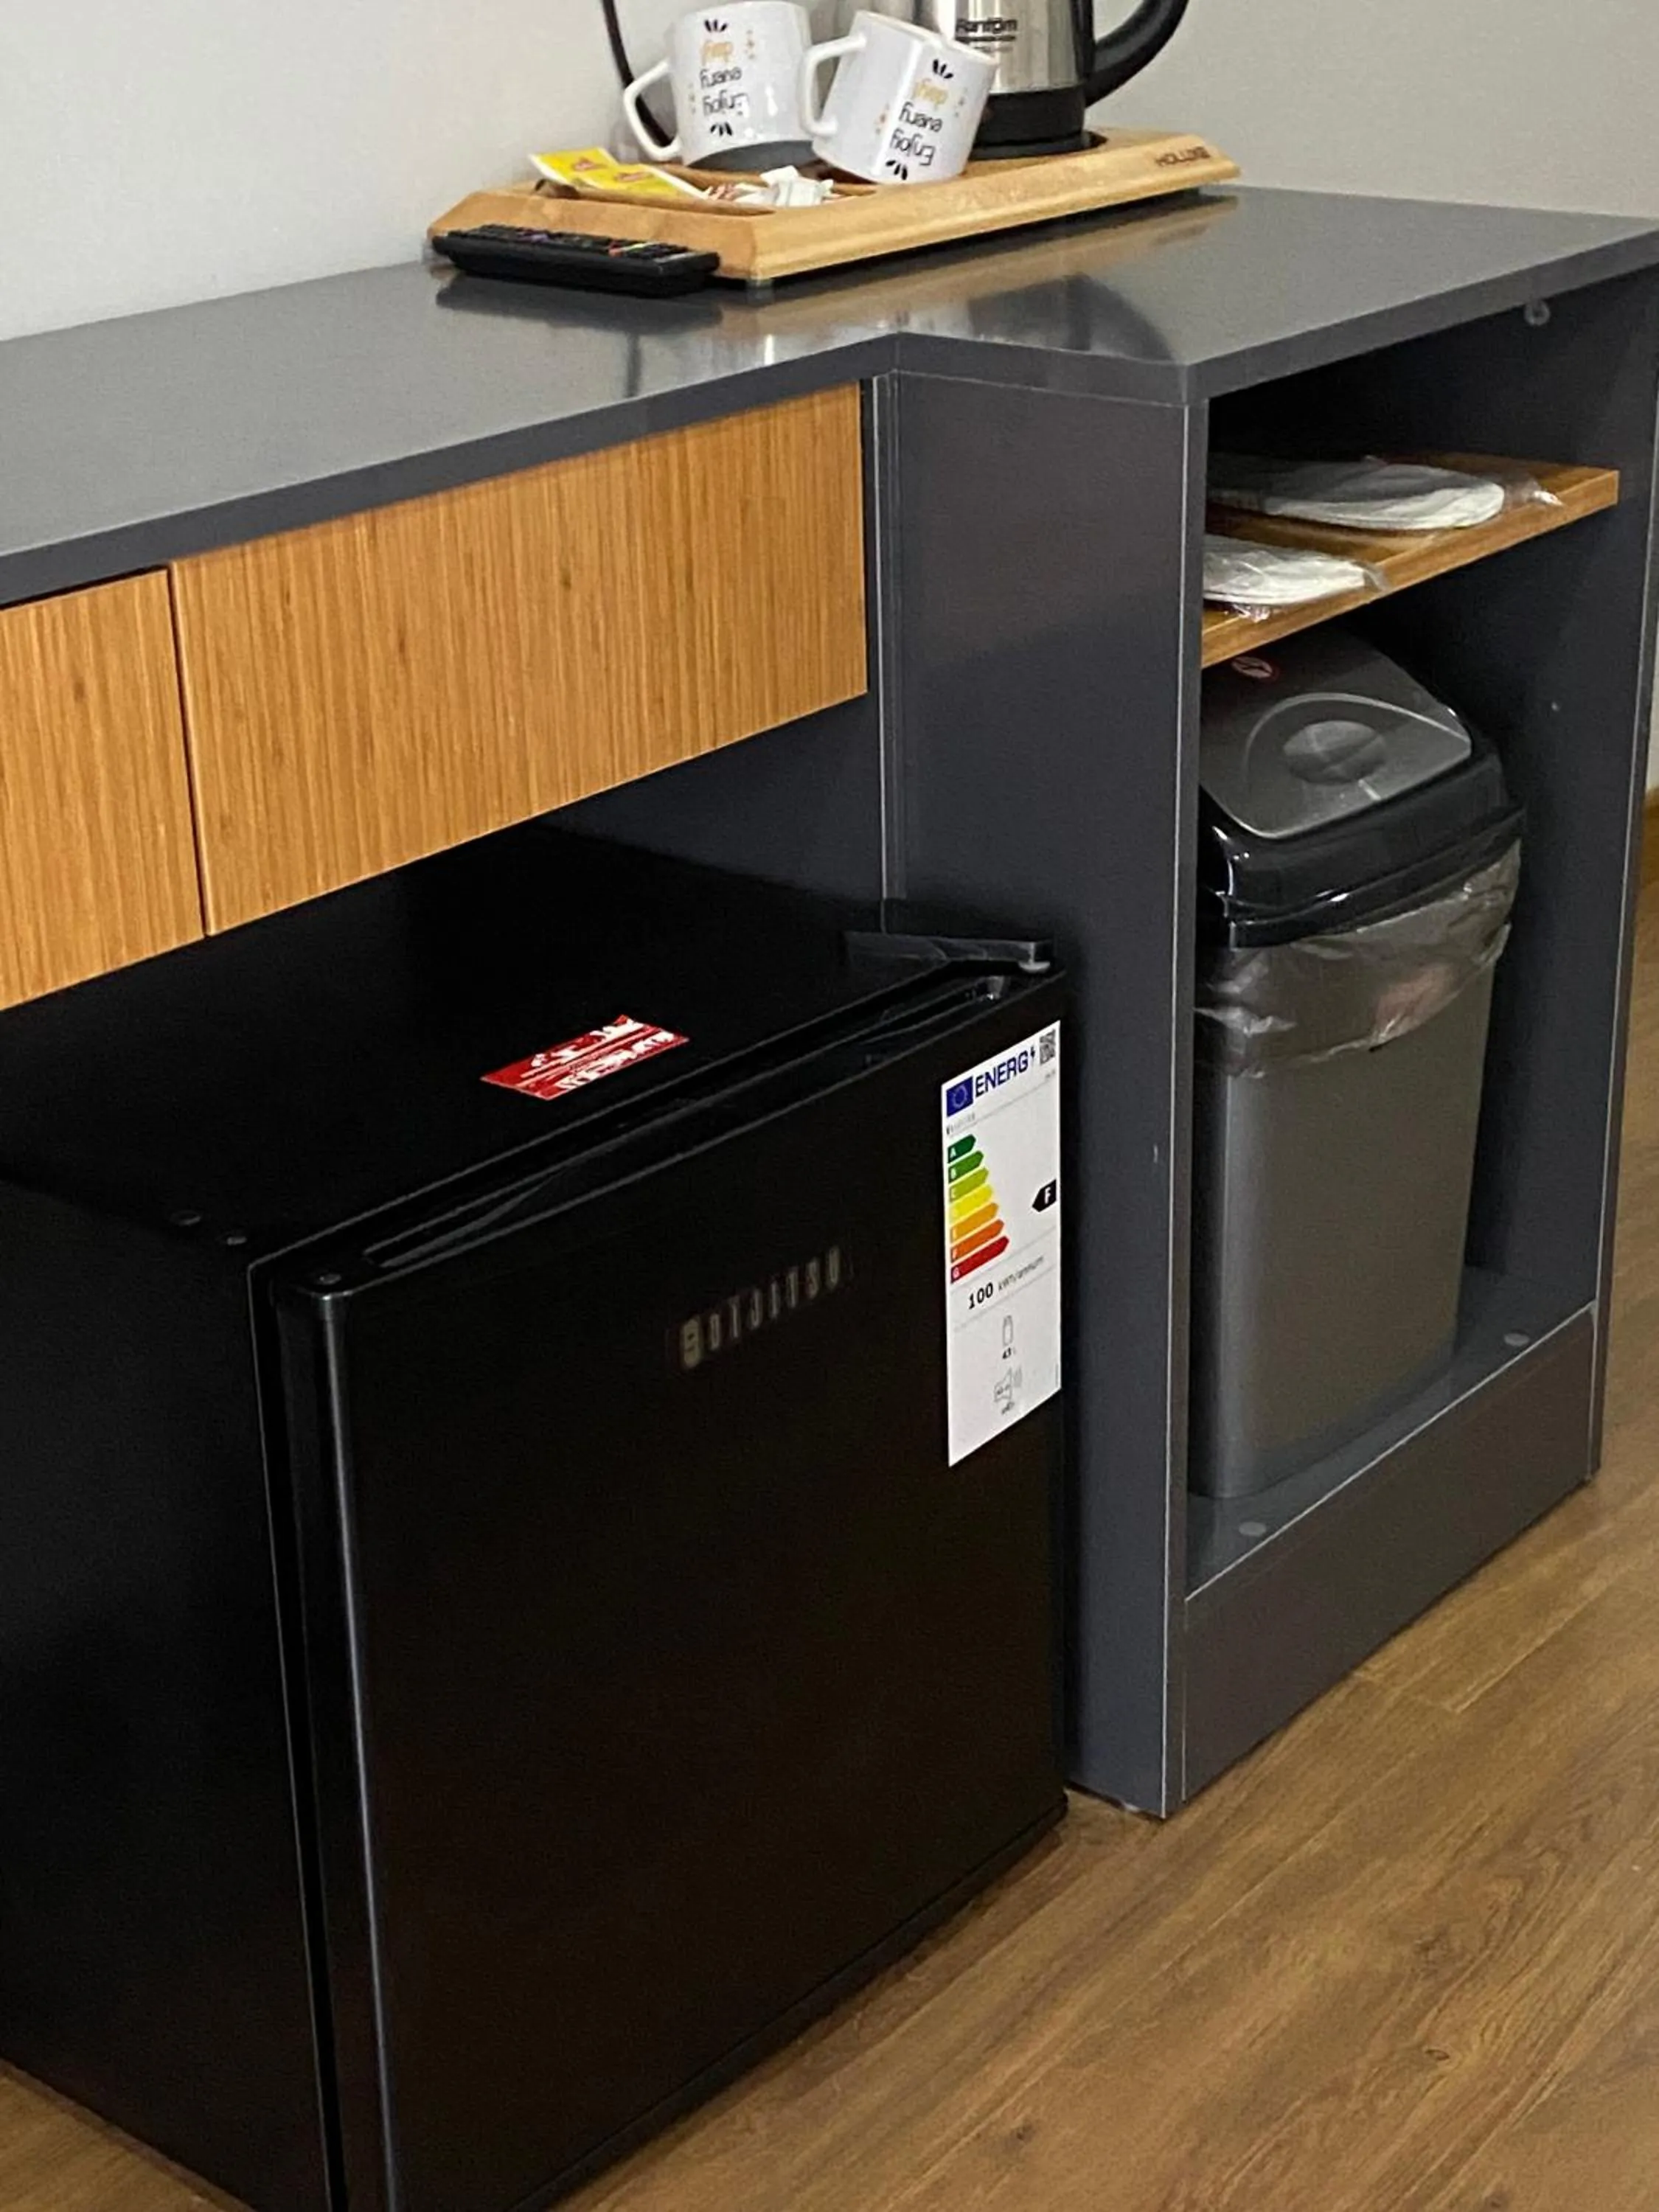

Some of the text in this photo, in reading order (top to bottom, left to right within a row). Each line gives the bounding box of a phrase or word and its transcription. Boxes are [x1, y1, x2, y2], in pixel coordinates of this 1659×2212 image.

[699, 67, 742, 90] every
[898, 102, 943, 133] every
[889, 128, 936, 167] Enjoy
[950, 1148, 956, 1159] A
[950, 1168, 957, 1180] B
[1043, 1186, 1051, 1204] F
[967, 1281, 994, 1310] 100
